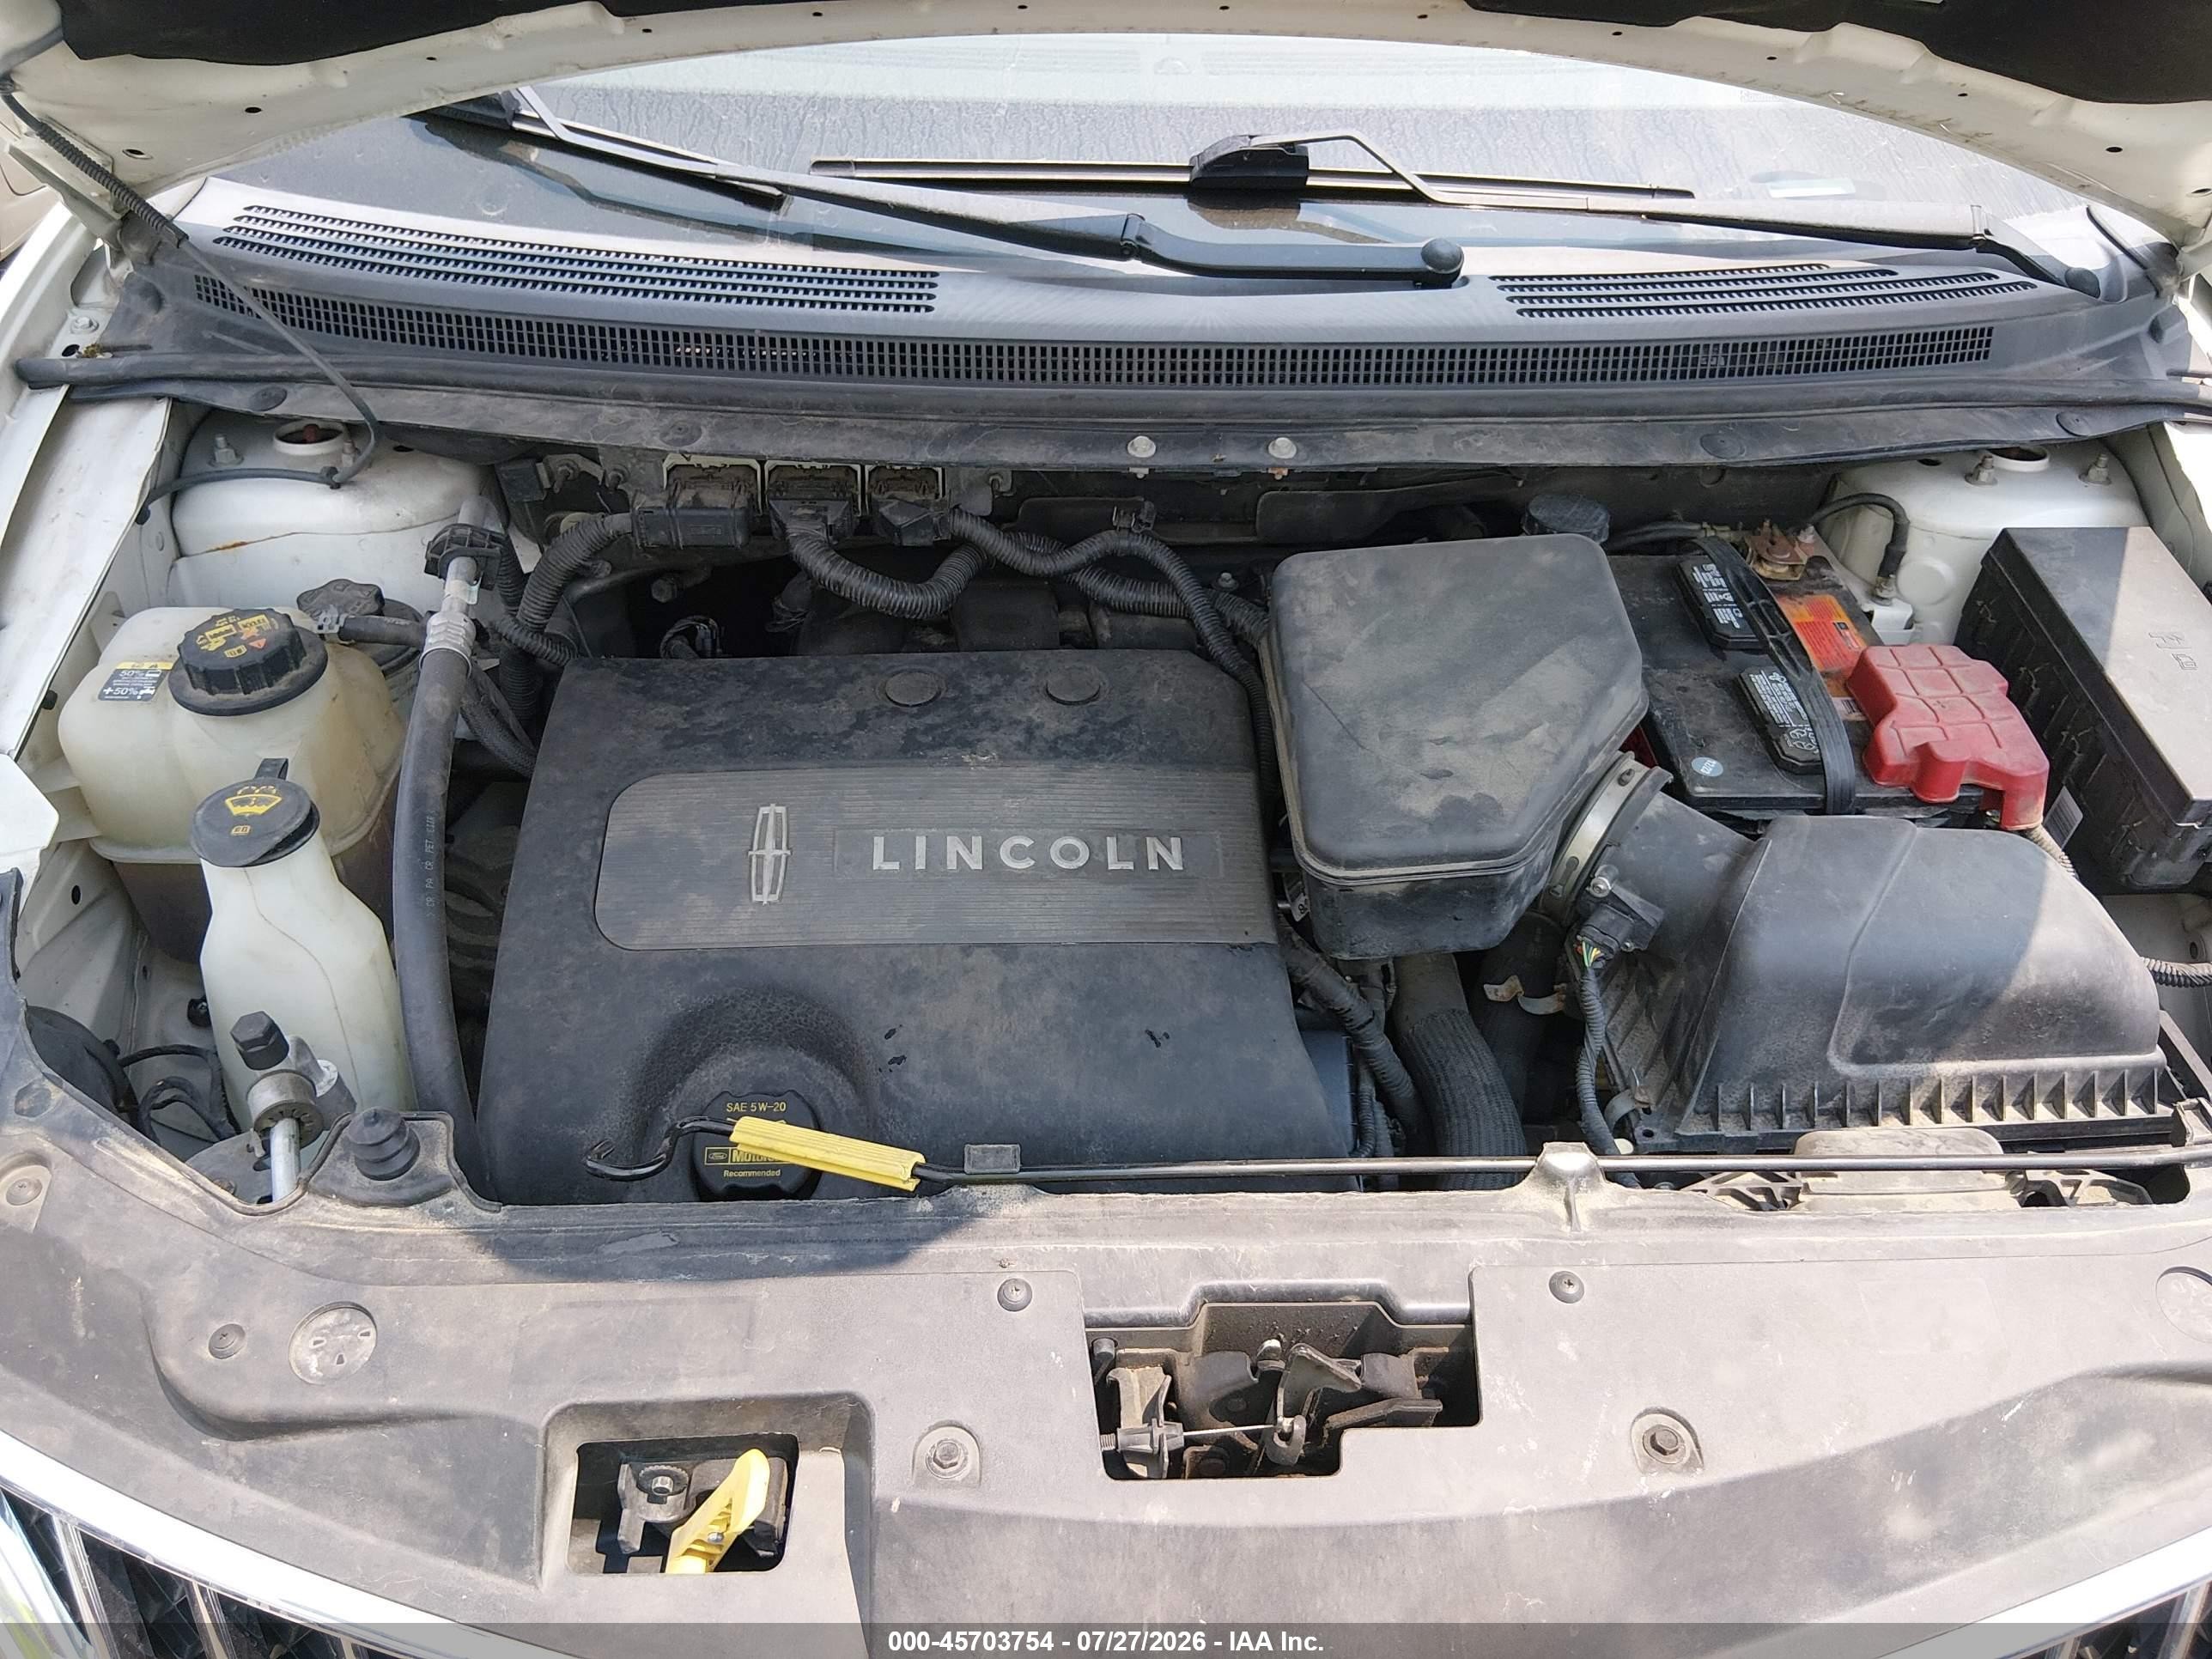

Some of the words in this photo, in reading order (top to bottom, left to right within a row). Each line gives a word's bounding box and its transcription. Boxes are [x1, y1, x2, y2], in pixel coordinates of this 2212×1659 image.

[872, 836, 1183, 871] LINCOLN
[726, 1102, 748, 1112] SAE
[723, 1169, 781, 1177] Recommended
